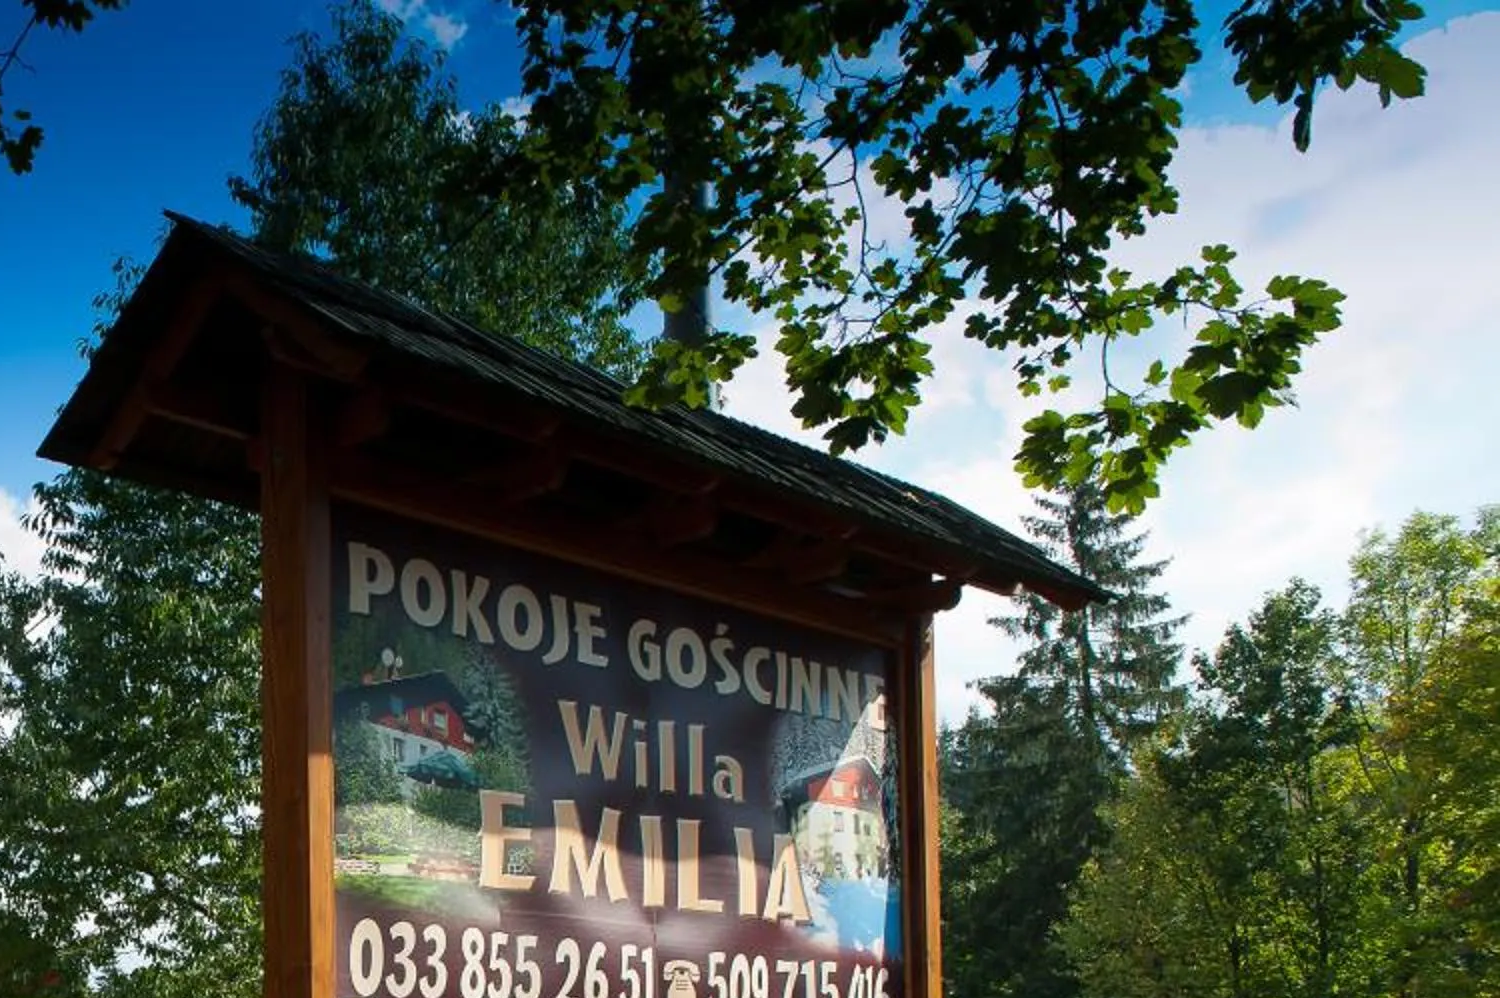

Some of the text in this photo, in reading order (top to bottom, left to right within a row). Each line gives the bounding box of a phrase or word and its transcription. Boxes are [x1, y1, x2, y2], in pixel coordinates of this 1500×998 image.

[347, 541, 886, 731] POKOJE GOŚCINNE
[558, 700, 744, 803] Willa
[478, 788, 812, 926] EMILIA
